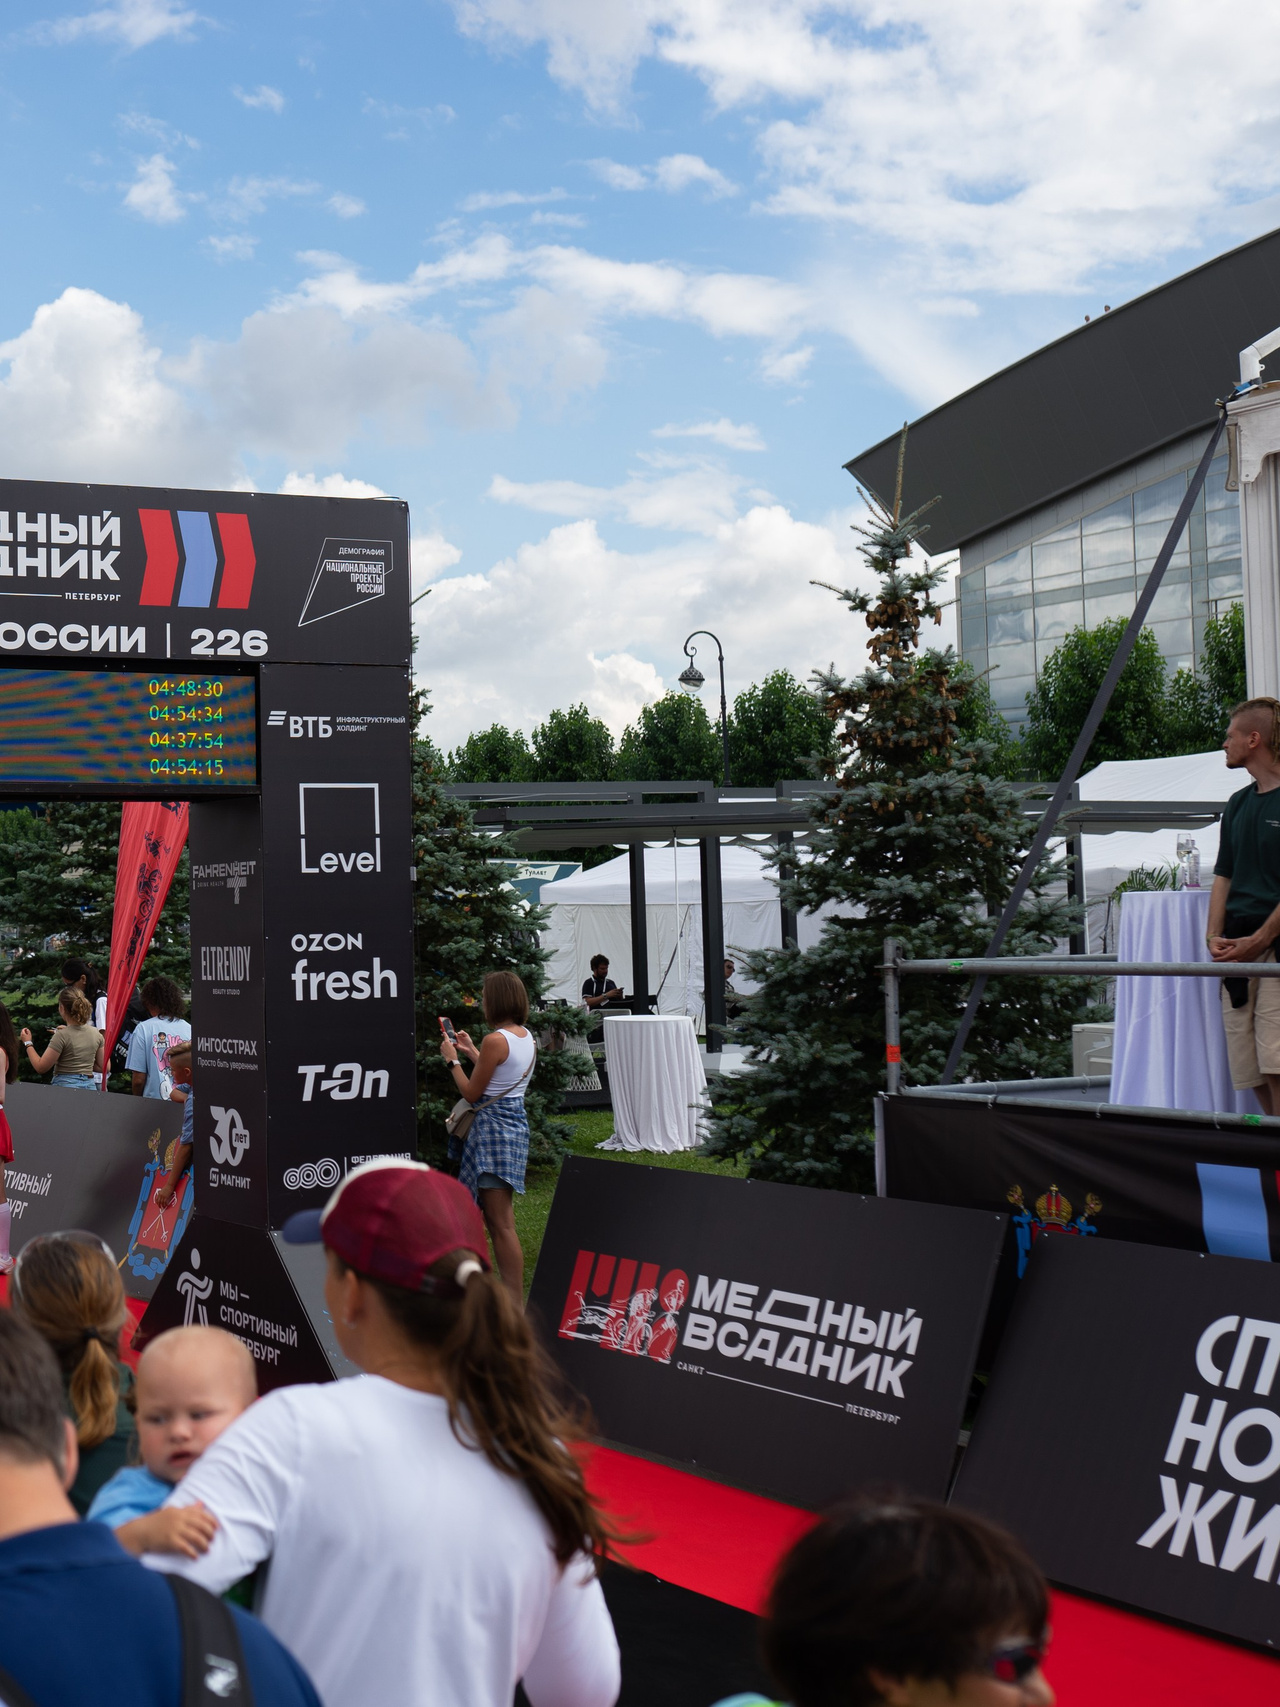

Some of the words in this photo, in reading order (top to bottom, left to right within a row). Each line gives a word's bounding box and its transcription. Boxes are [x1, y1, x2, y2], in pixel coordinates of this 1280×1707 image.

[338, 546, 385, 556] ДЕМОГРАФИЯ
[326, 561, 383, 574] НАЦИОНАЛЬНЫЕ
[350, 573, 383, 584] ПРОЕКТЫ
[64, 592, 121, 601] ПЕТЕРБУРГ
[356, 583, 383, 594] РОССИИ
[190, 627, 269, 657] 226
[149, 679, 223, 698] 04:48:30
[149, 705, 223, 724] 04:54:34
[288, 714, 333, 739] ВТБ
[336, 715, 407, 725] ИНФРАСТРУКТУРНЫЙ
[335, 724, 369, 733] ХОЛДИНГ
[149, 731, 223, 750] 04:37:54
[149, 757, 223, 776] 04:54:15
[300, 837, 382, 874] Level
[192, 860, 257, 879] FAHRENHEIT
[291, 932, 363, 953] OZON
[200, 945, 251, 983] ELTRENDY
[290, 956, 398, 1002] fresh
[197, 1036, 258, 1056] ИНГОССТРАХ
[197, 1056, 217, 1068] Просто
[217, 1058, 229, 1069] быть
[230, 1061, 259, 1071] уверенным
[220, 1173, 252, 1190] МАГНИТ
[220, 1279, 239, 1302] МЫ
[691, 1274, 923, 1356] МЕДНЫЙ
[219, 1304, 299, 1348] СПОРТИВНЫЙ
[682, 1313, 914, 1399] ВСАДНИК
[676, 1360, 706, 1376] САНКТ
[844, 1402, 902, 1426] ПЕТЕРБУРГ
[1135, 1474, 1280, 1587] ЖИ
